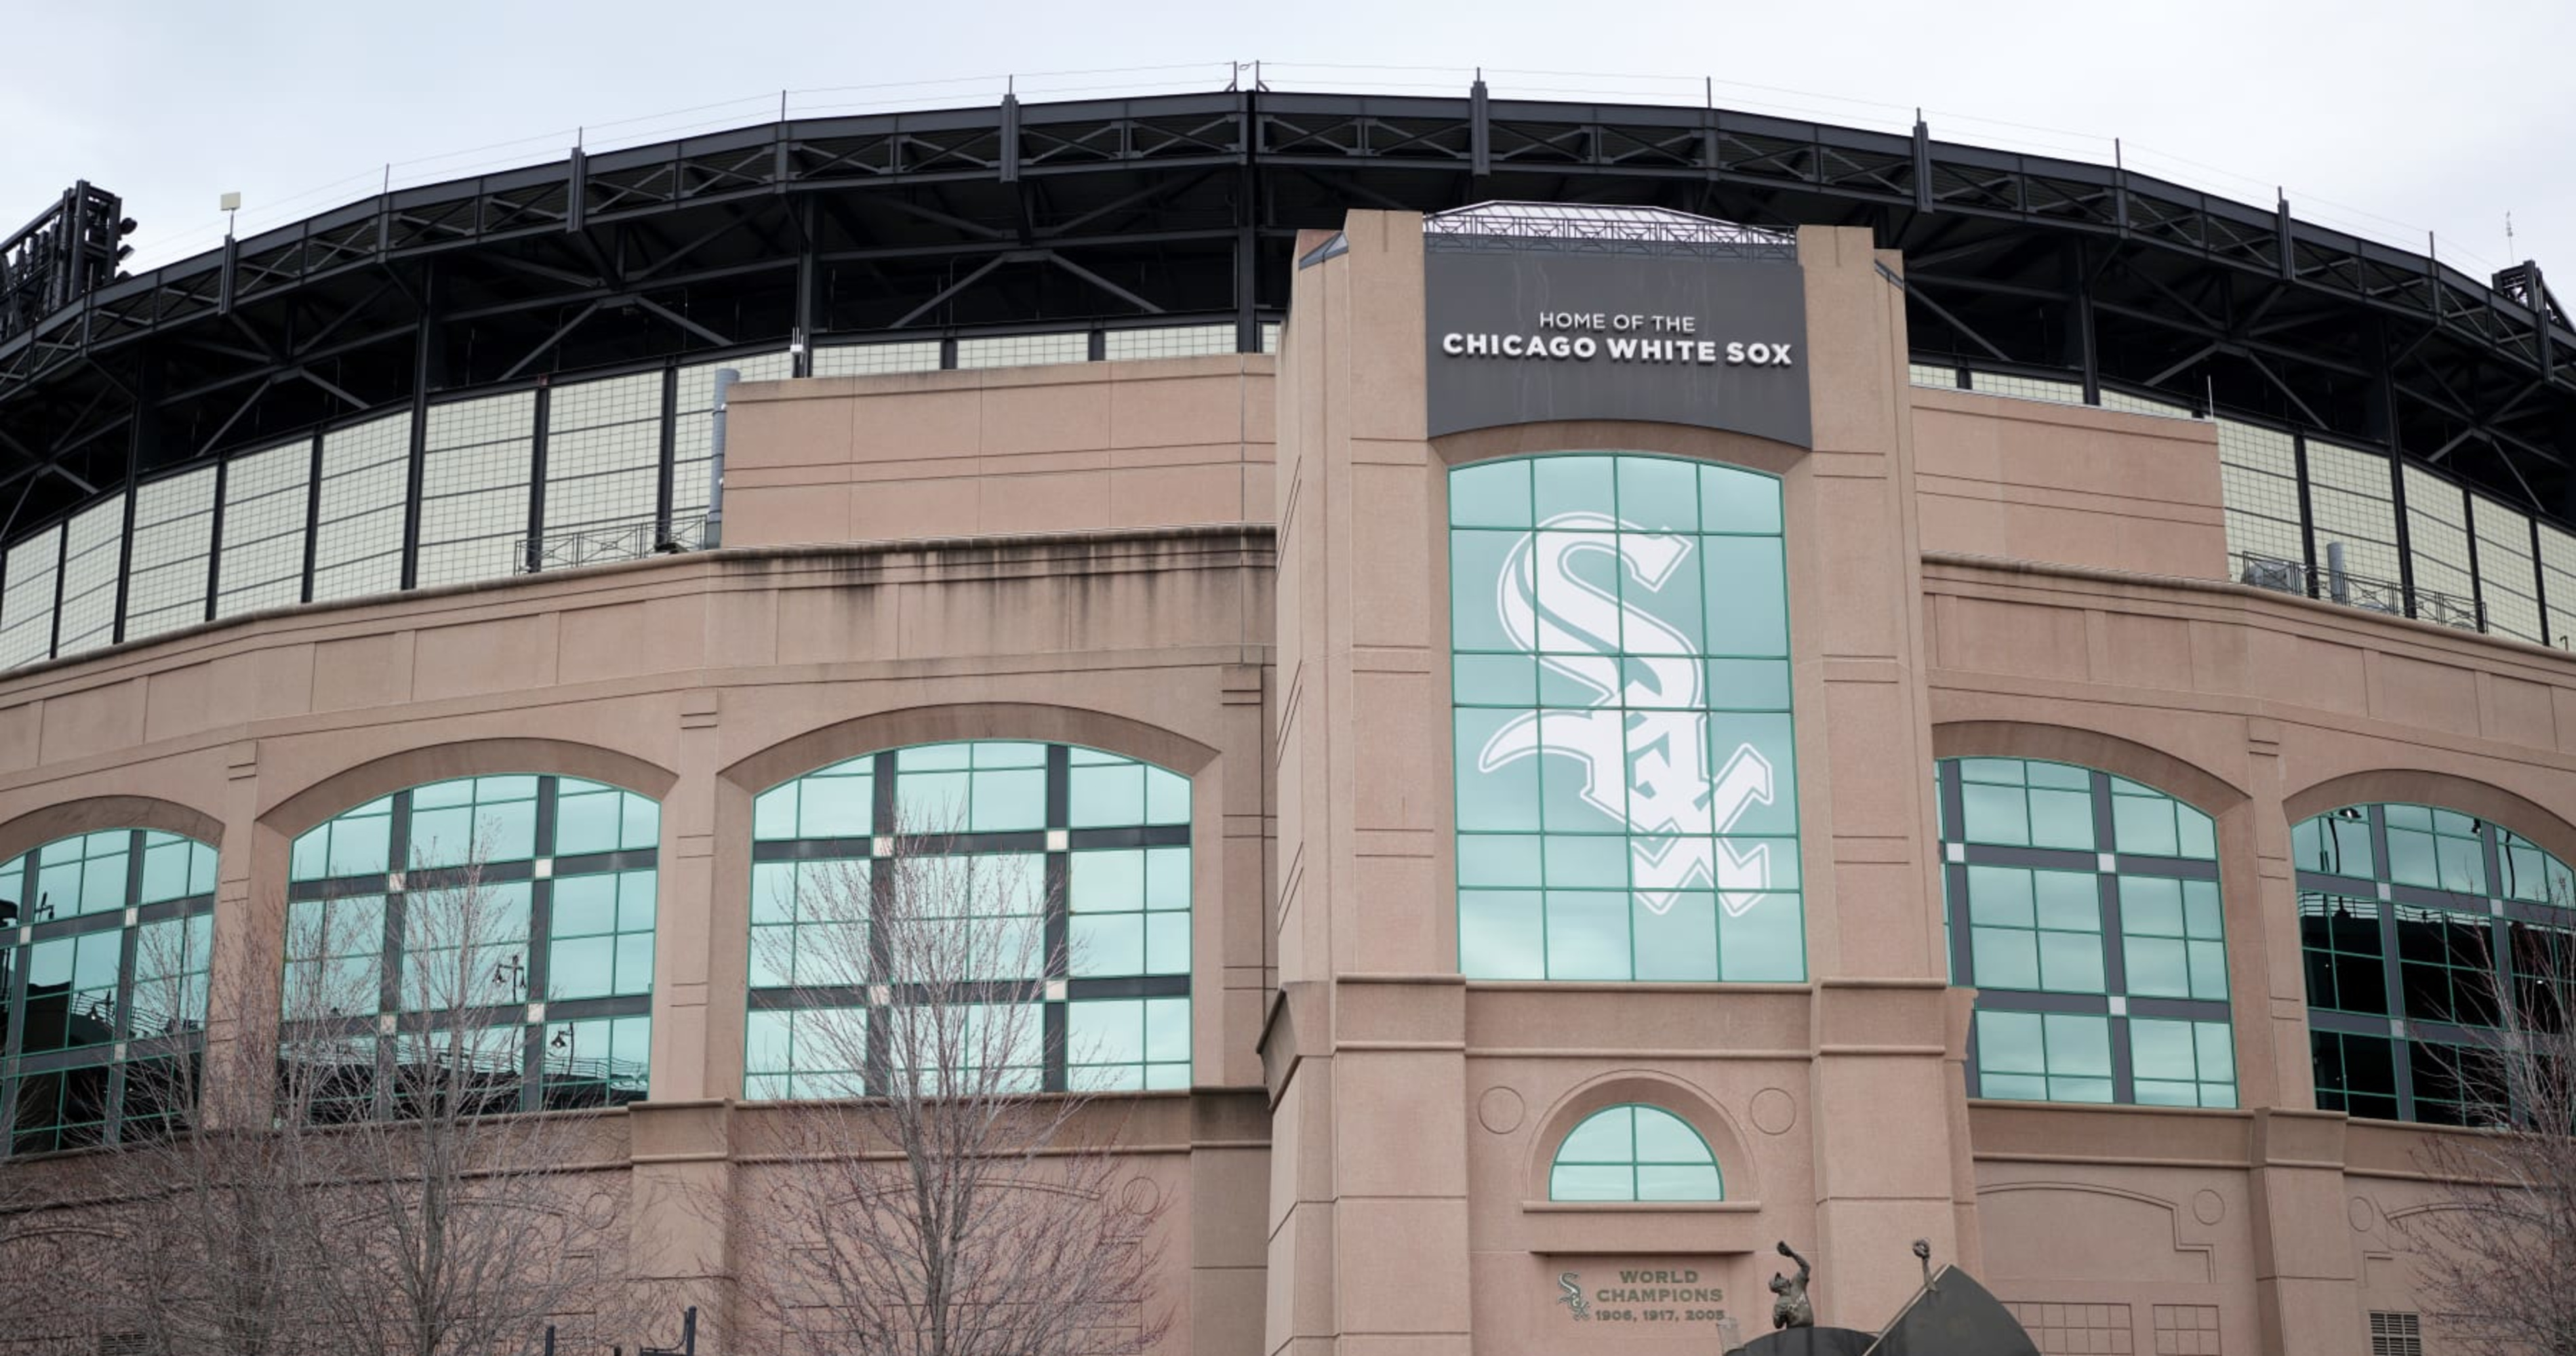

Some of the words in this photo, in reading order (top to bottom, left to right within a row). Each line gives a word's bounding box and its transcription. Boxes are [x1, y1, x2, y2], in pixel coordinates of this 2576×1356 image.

[1539, 311, 1607, 330] HOME
[1613, 315, 1645, 331] OF
[1651, 316, 1696, 332] THE
[1442, 333, 1598, 357] CHICAGO
[1605, 337, 1717, 362] WHITE
[1725, 342, 1792, 365] SOX
[1619, 1271, 1699, 1283] WORLD
[1596, 1289, 1724, 1302] CHAMPIONS
[1595, 1310, 1638, 1322] 1906,
[1643, 1310, 1680, 1322] 1917,
[1685, 1310, 1725, 1321] 2005
